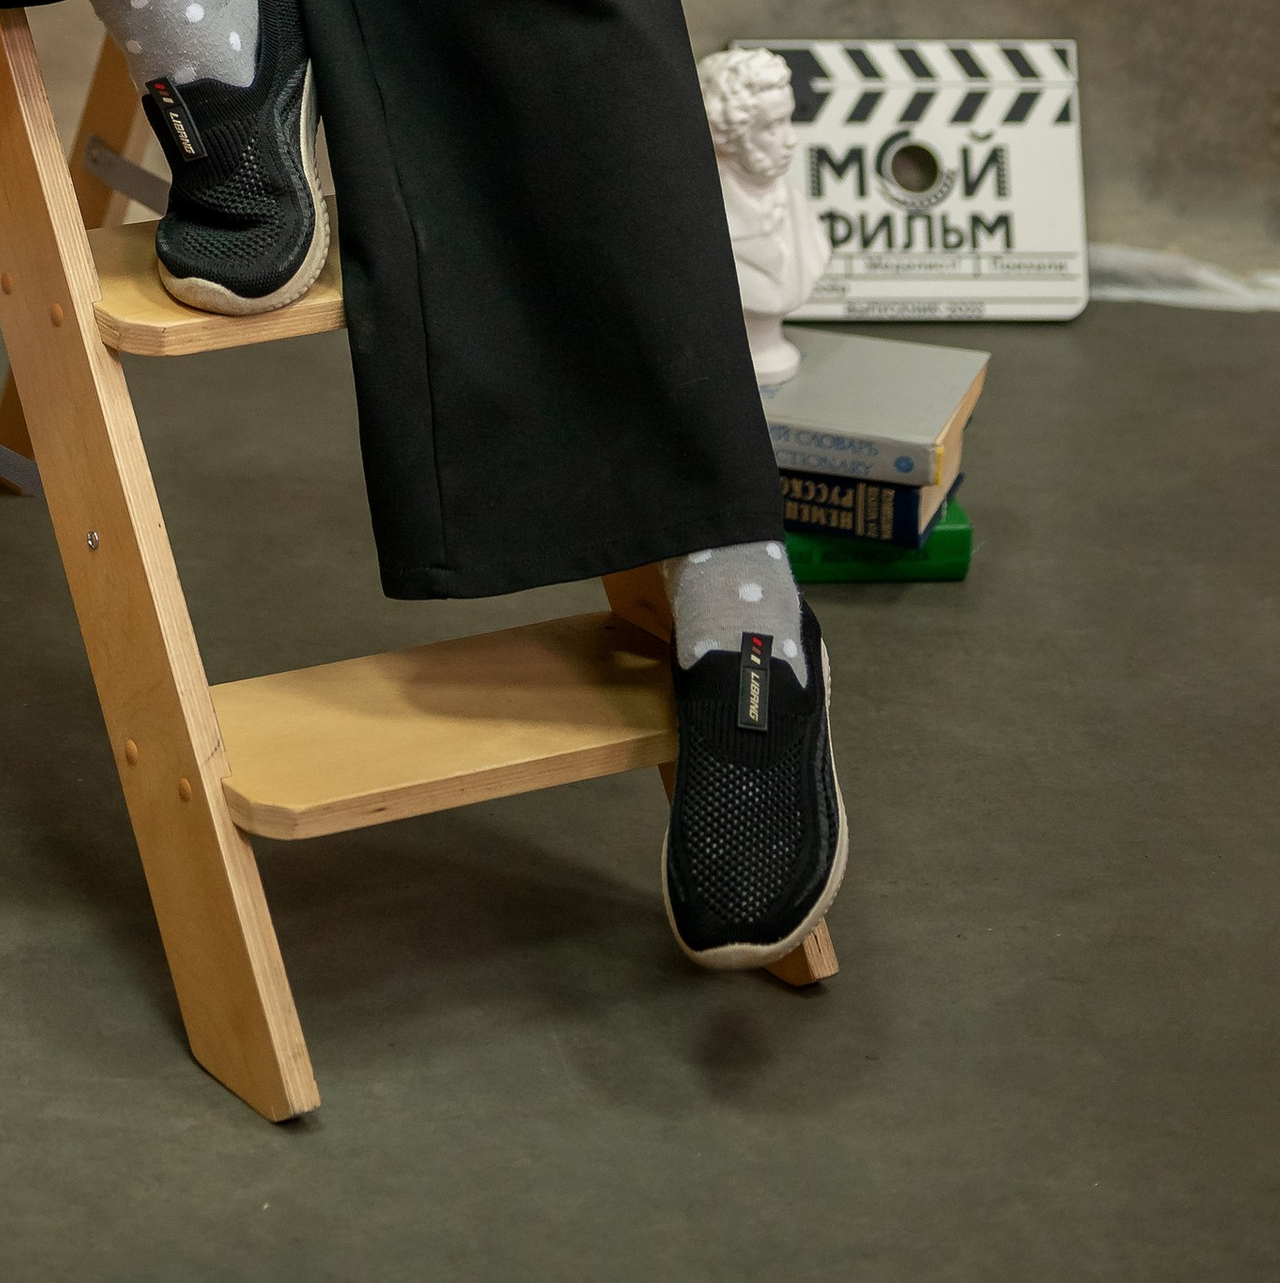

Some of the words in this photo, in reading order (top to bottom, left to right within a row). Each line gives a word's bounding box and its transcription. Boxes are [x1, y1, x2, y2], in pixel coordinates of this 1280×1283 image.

[809, 128, 1010, 211] МОЙ
[819, 209, 1014, 252] ФИЛЬМ
[794, 428, 879, 457] СЛОВАРЬ
[776, 449, 875, 476] CTIONARY
